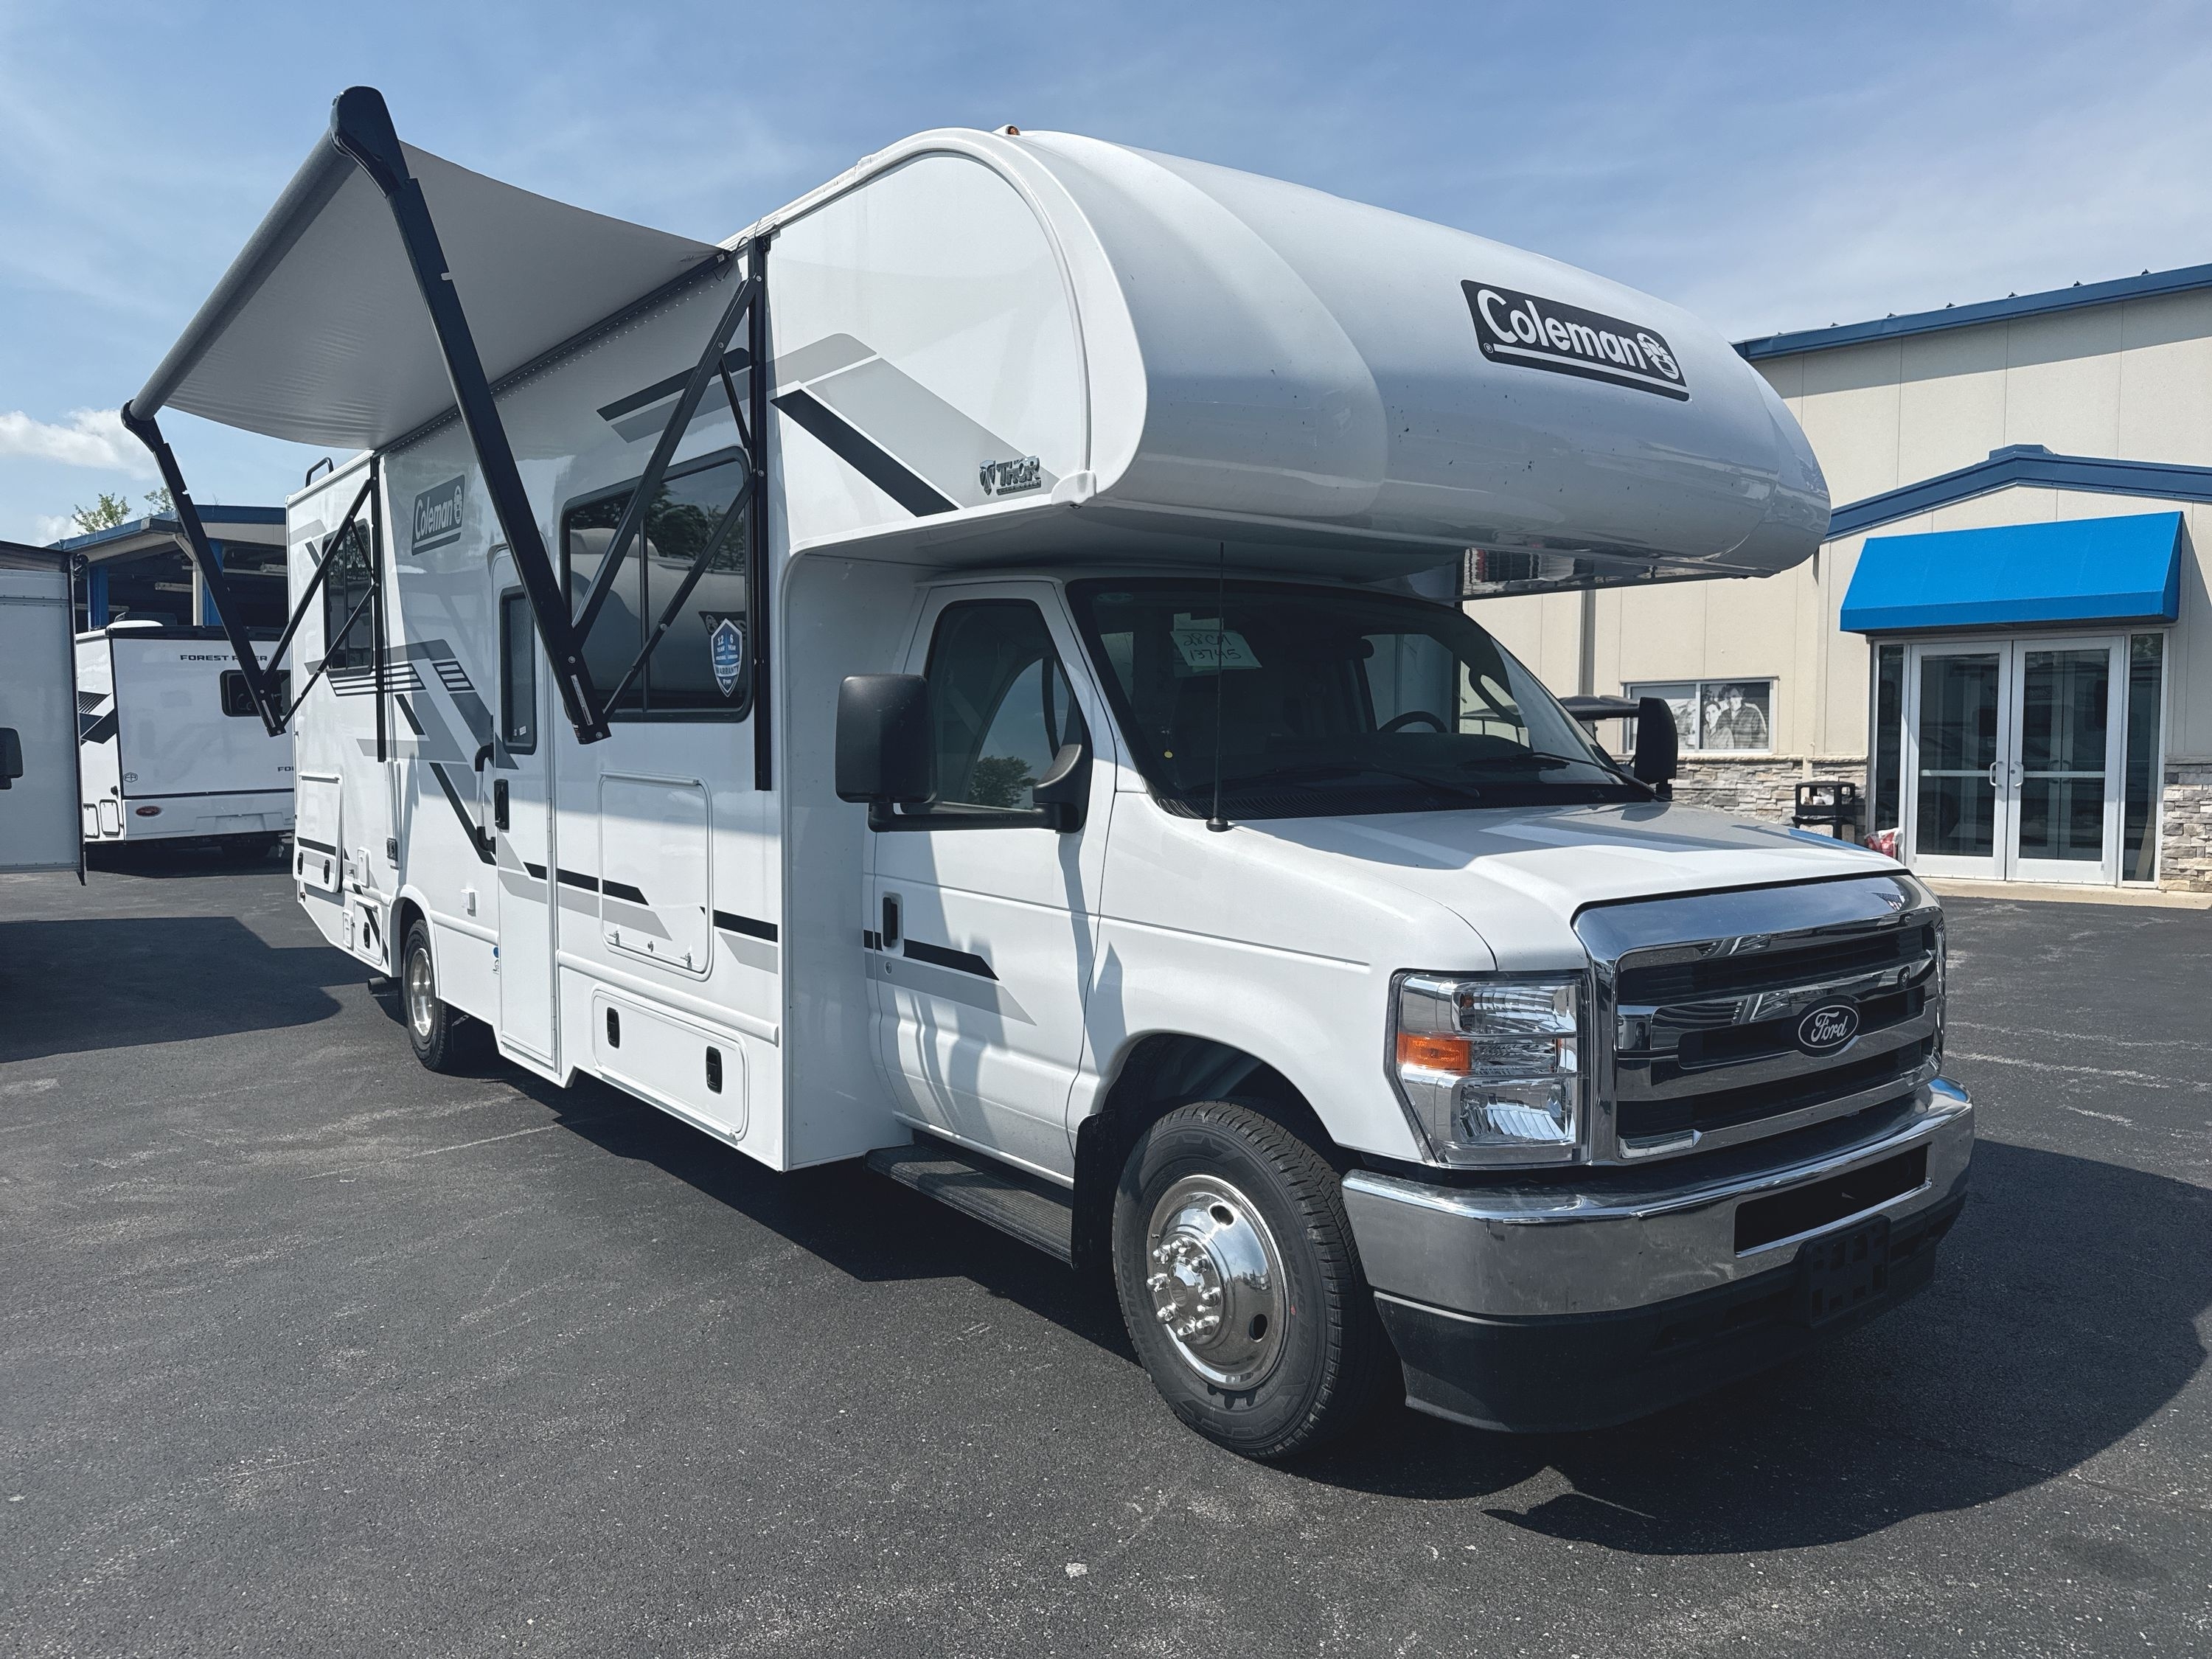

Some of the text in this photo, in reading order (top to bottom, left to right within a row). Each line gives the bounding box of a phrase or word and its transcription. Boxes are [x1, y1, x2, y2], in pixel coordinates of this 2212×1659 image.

[1477, 288, 1648, 370] Coleman
[996, 455, 1041, 487] THOR
[415, 495, 453, 540] Coleman
[1810, 1011, 1848, 1043] Ford
